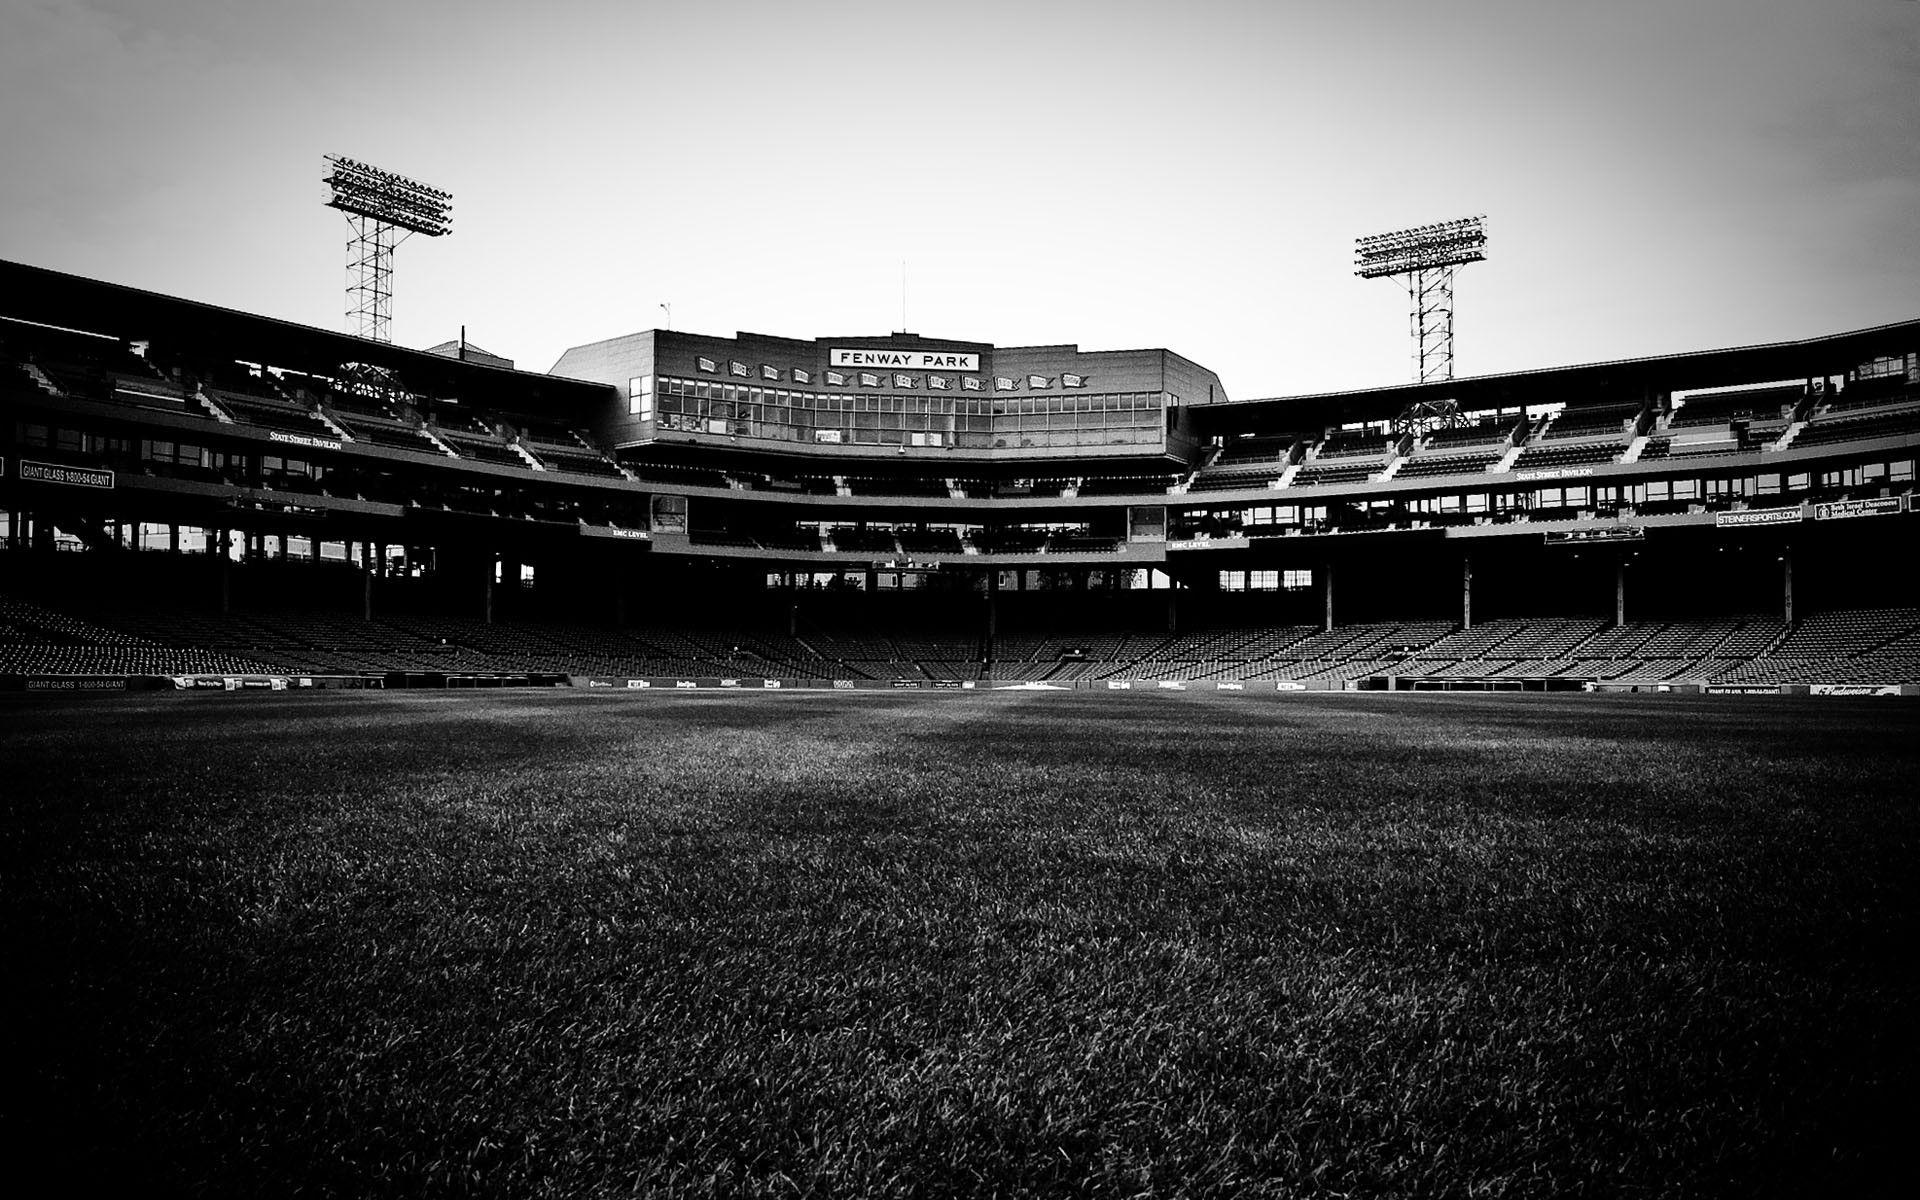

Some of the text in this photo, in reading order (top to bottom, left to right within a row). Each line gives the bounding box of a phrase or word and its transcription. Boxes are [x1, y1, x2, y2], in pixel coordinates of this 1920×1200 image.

[840, 353, 969, 368] FENWAY PARK
[269, 431, 342, 450] STATE STREET PAVILION
[23, 465, 44, 478] GIANT
[44, 467, 65, 481] GLASS
[1718, 511, 1801, 525] STEINERSPORTS.COM
[628, 531, 649, 539] LEVEL
[1188, 540, 1211, 548] LEVEL
[28, 681, 50, 689] GIANT
[50, 681, 75, 689] GLASS
